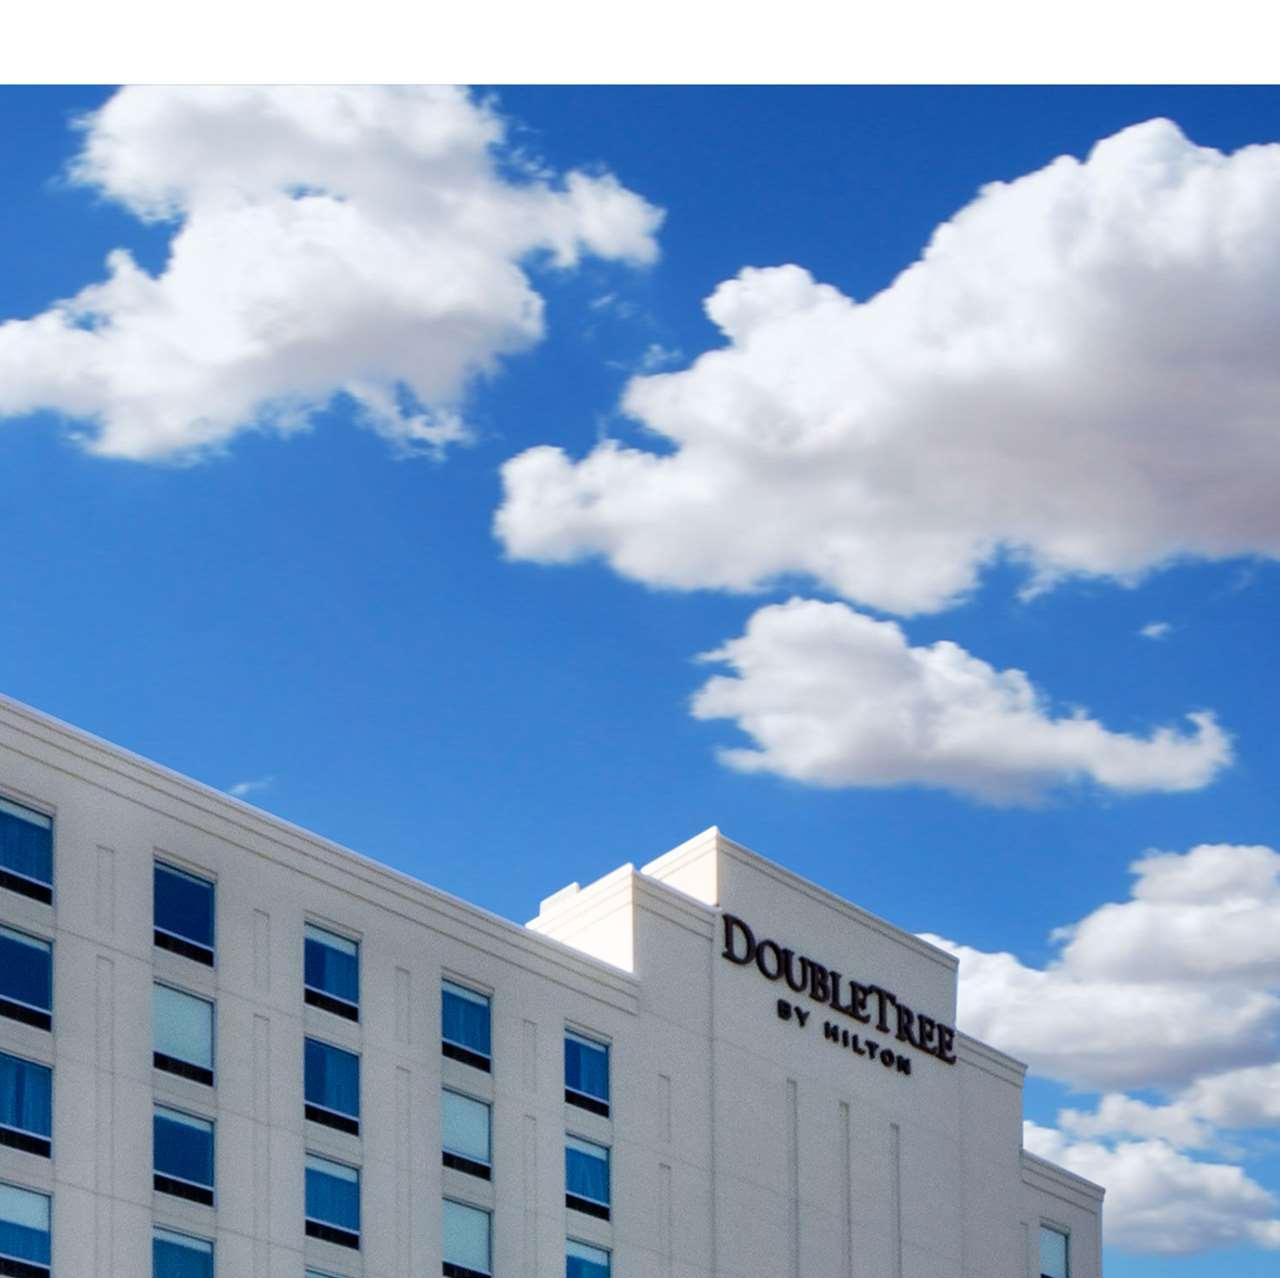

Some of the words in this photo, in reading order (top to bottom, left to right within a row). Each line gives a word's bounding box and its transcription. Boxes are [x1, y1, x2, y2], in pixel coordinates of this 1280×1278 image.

[721, 913, 957, 1065] DOUBLETREE
[776, 998, 811, 1028] BY
[823, 1021, 912, 1076] HILTON
